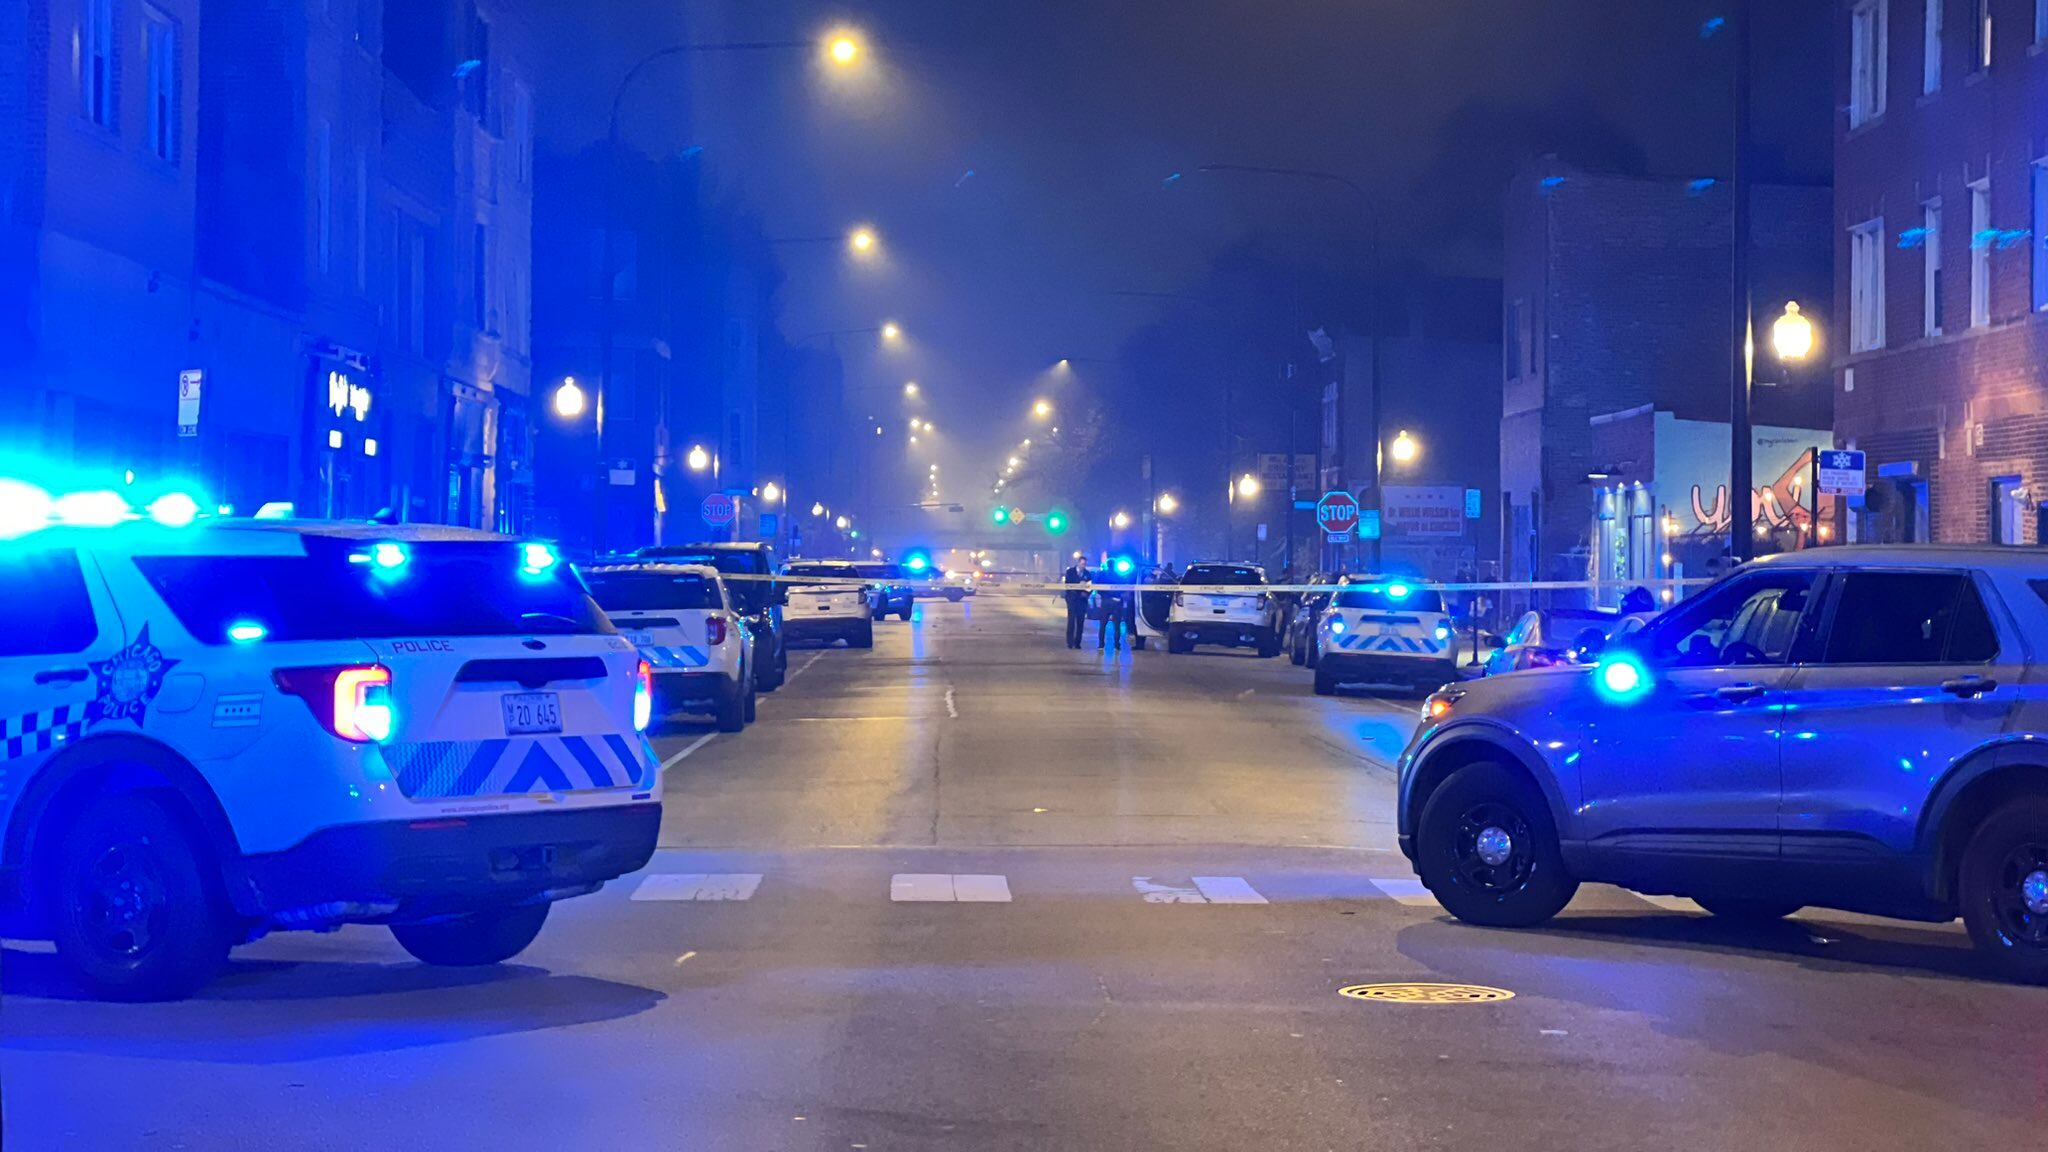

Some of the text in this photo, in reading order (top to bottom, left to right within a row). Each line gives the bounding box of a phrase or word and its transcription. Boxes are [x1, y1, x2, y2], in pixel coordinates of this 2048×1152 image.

[703, 504, 732, 516] STOP
[1321, 504, 1356, 521] STOP
[391, 640, 455, 654] POLICE
[102, 644, 162, 676] CHICAGO
[98, 692, 149, 719] POLICE
[517, 705, 531, 726] 20
[537, 704, 557, 726] 645
